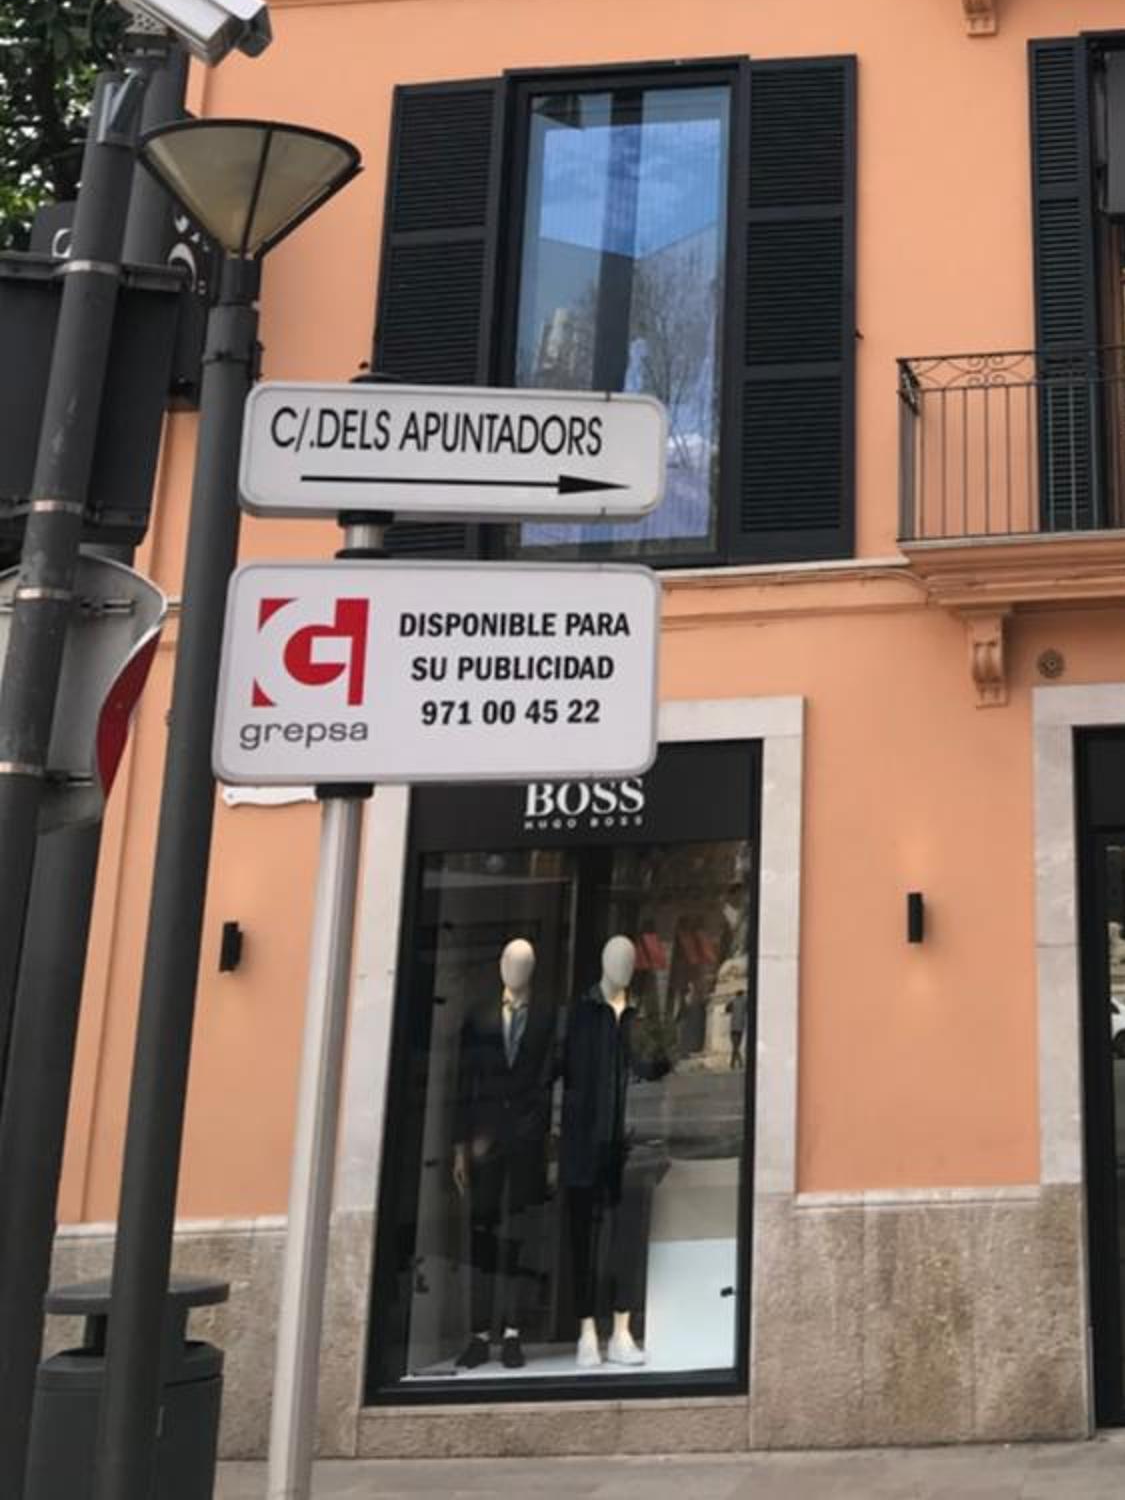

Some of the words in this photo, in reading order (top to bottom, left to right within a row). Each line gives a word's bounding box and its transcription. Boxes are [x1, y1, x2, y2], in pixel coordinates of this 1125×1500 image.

[400, 411, 603, 456] APUNTADORS
[400, 612, 557, 638] DISPONIBLE
[565, 612, 631, 637] PARA
[411, 656, 448, 682] SU
[458, 655, 615, 681] PUBLICIDAD
[421, 701, 472, 726] 971
[482, 701, 516, 725] 00
[525, 700, 559, 725] 45
[567, 699, 601, 724] 22
[239, 721, 369, 751] grepsa
[525, 778, 645, 816] BOSS
